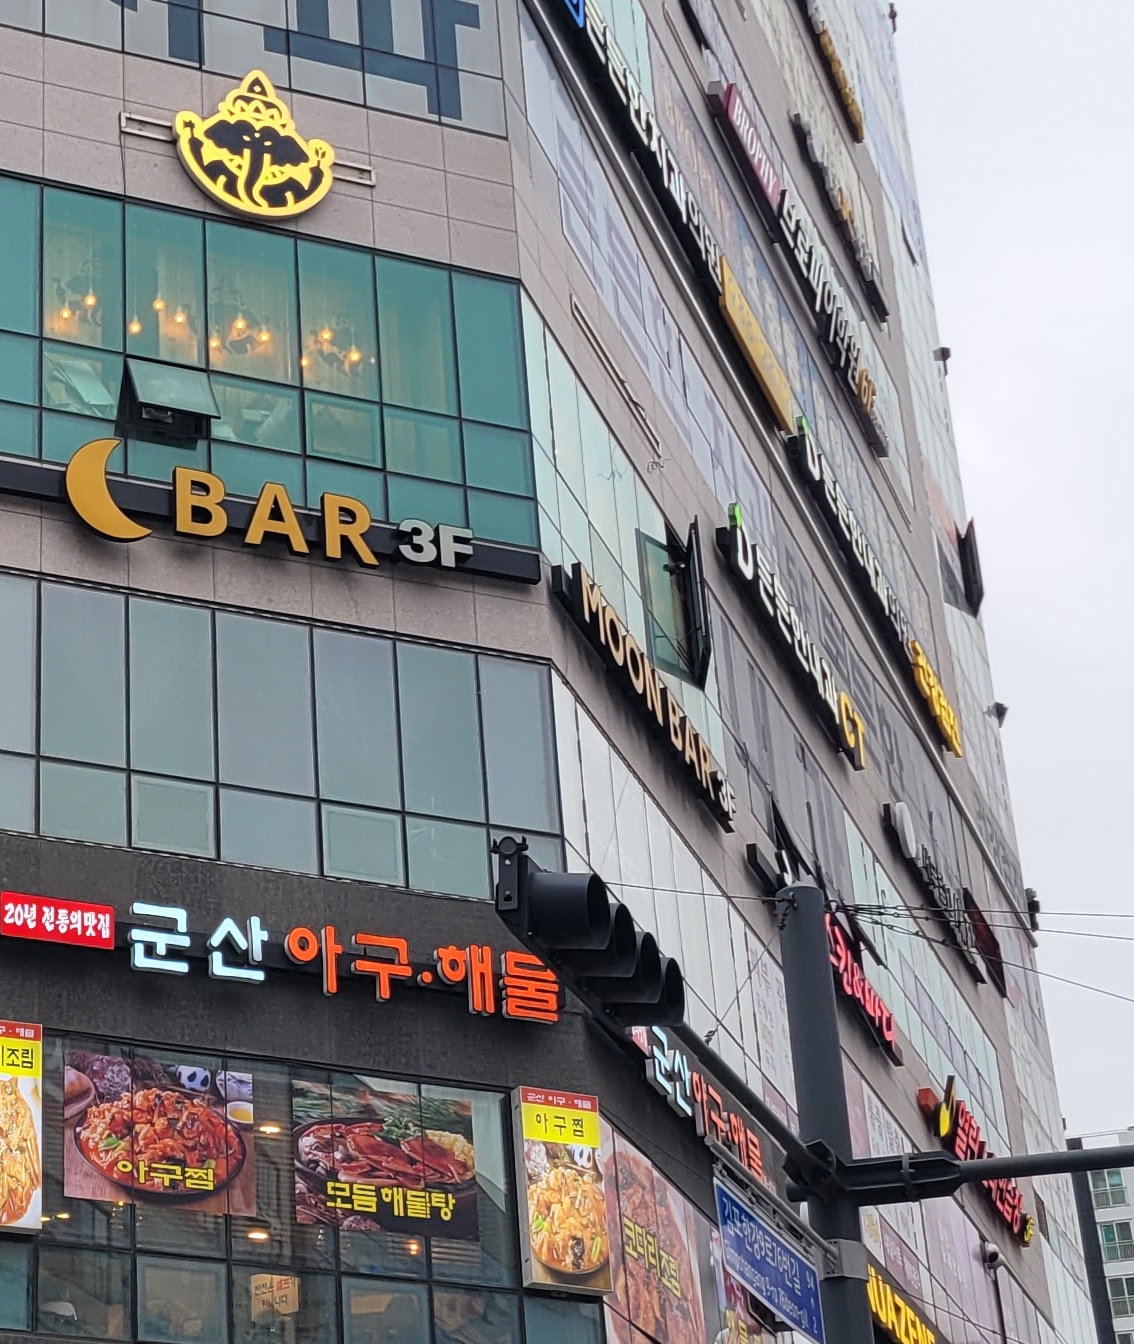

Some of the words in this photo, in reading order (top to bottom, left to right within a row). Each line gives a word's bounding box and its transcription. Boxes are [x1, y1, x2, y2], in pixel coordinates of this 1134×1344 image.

[732, 97, 780, 200] BROPHY
[173, 467, 380, 565] BAR
[397, 519, 474, 568] 3F
[580, 564, 664, 728] MOON
[666, 688, 716, 802] BAR
[3, 902, 38, 930] 20년
[129, 902, 268, 983] 군산
[535, 1112, 585, 1138] 아구찜
[116, 1158, 216, 1191] 아구찜
